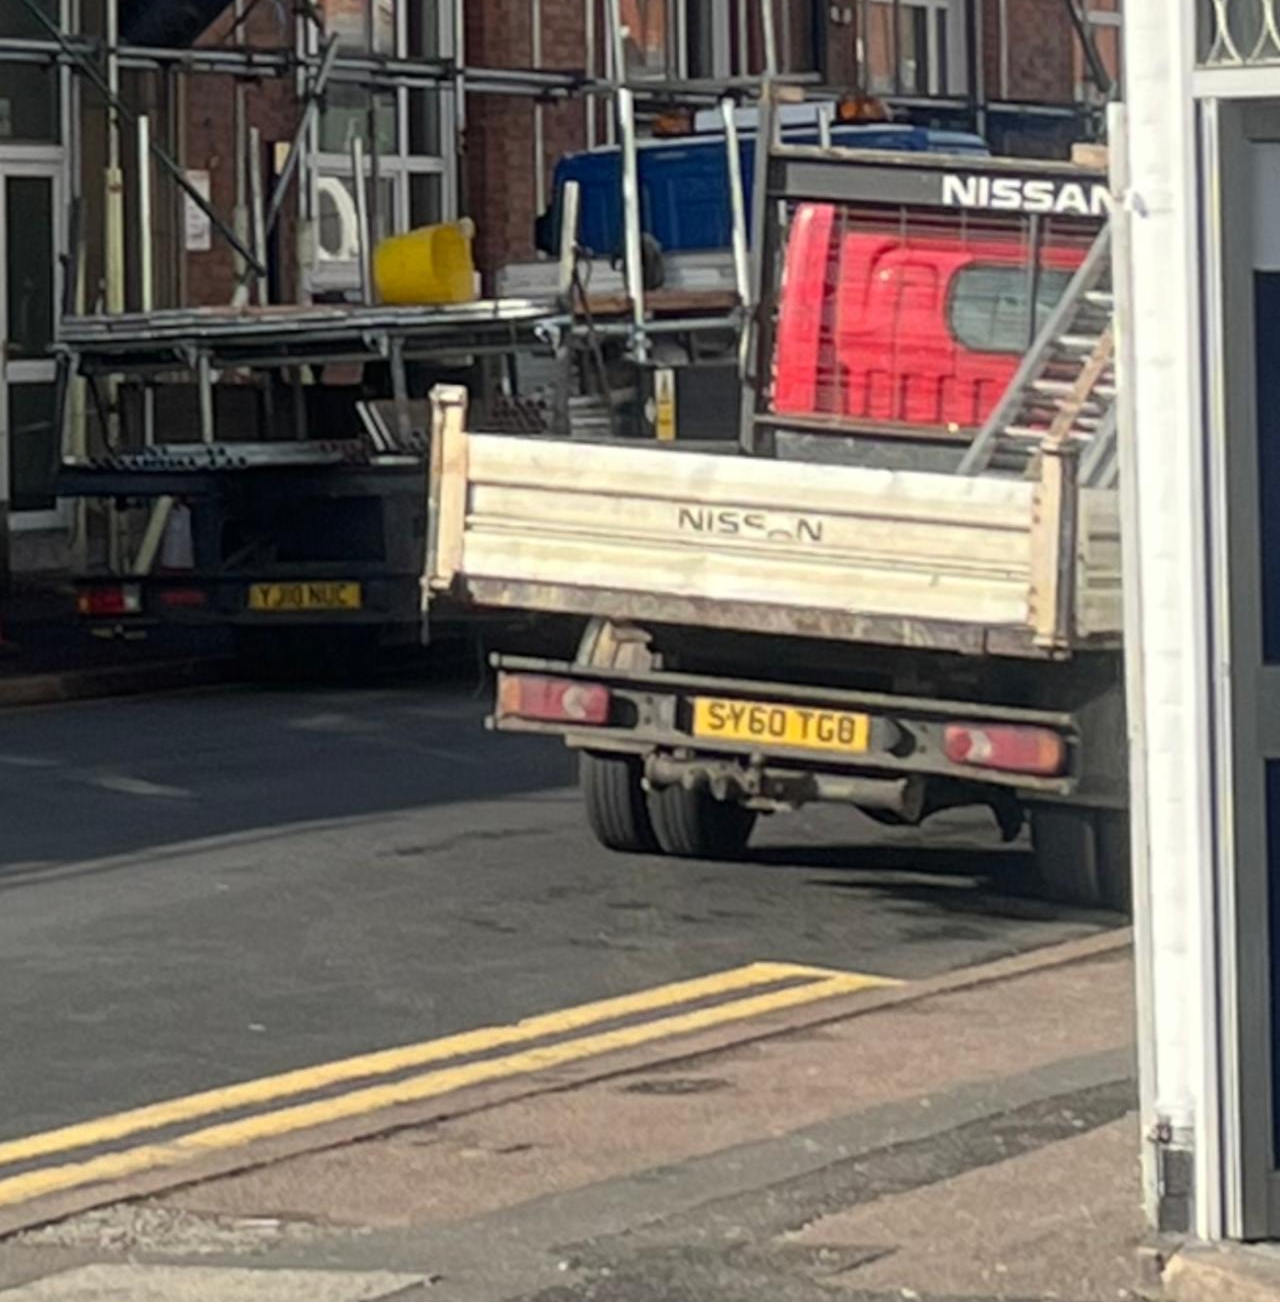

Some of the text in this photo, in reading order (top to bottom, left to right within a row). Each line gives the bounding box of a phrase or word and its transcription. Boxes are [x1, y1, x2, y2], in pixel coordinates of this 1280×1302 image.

[942, 175, 1111, 215] NISSAN
[679, 508, 823, 541] NISSN
[707, 700, 786, 737] SY60
